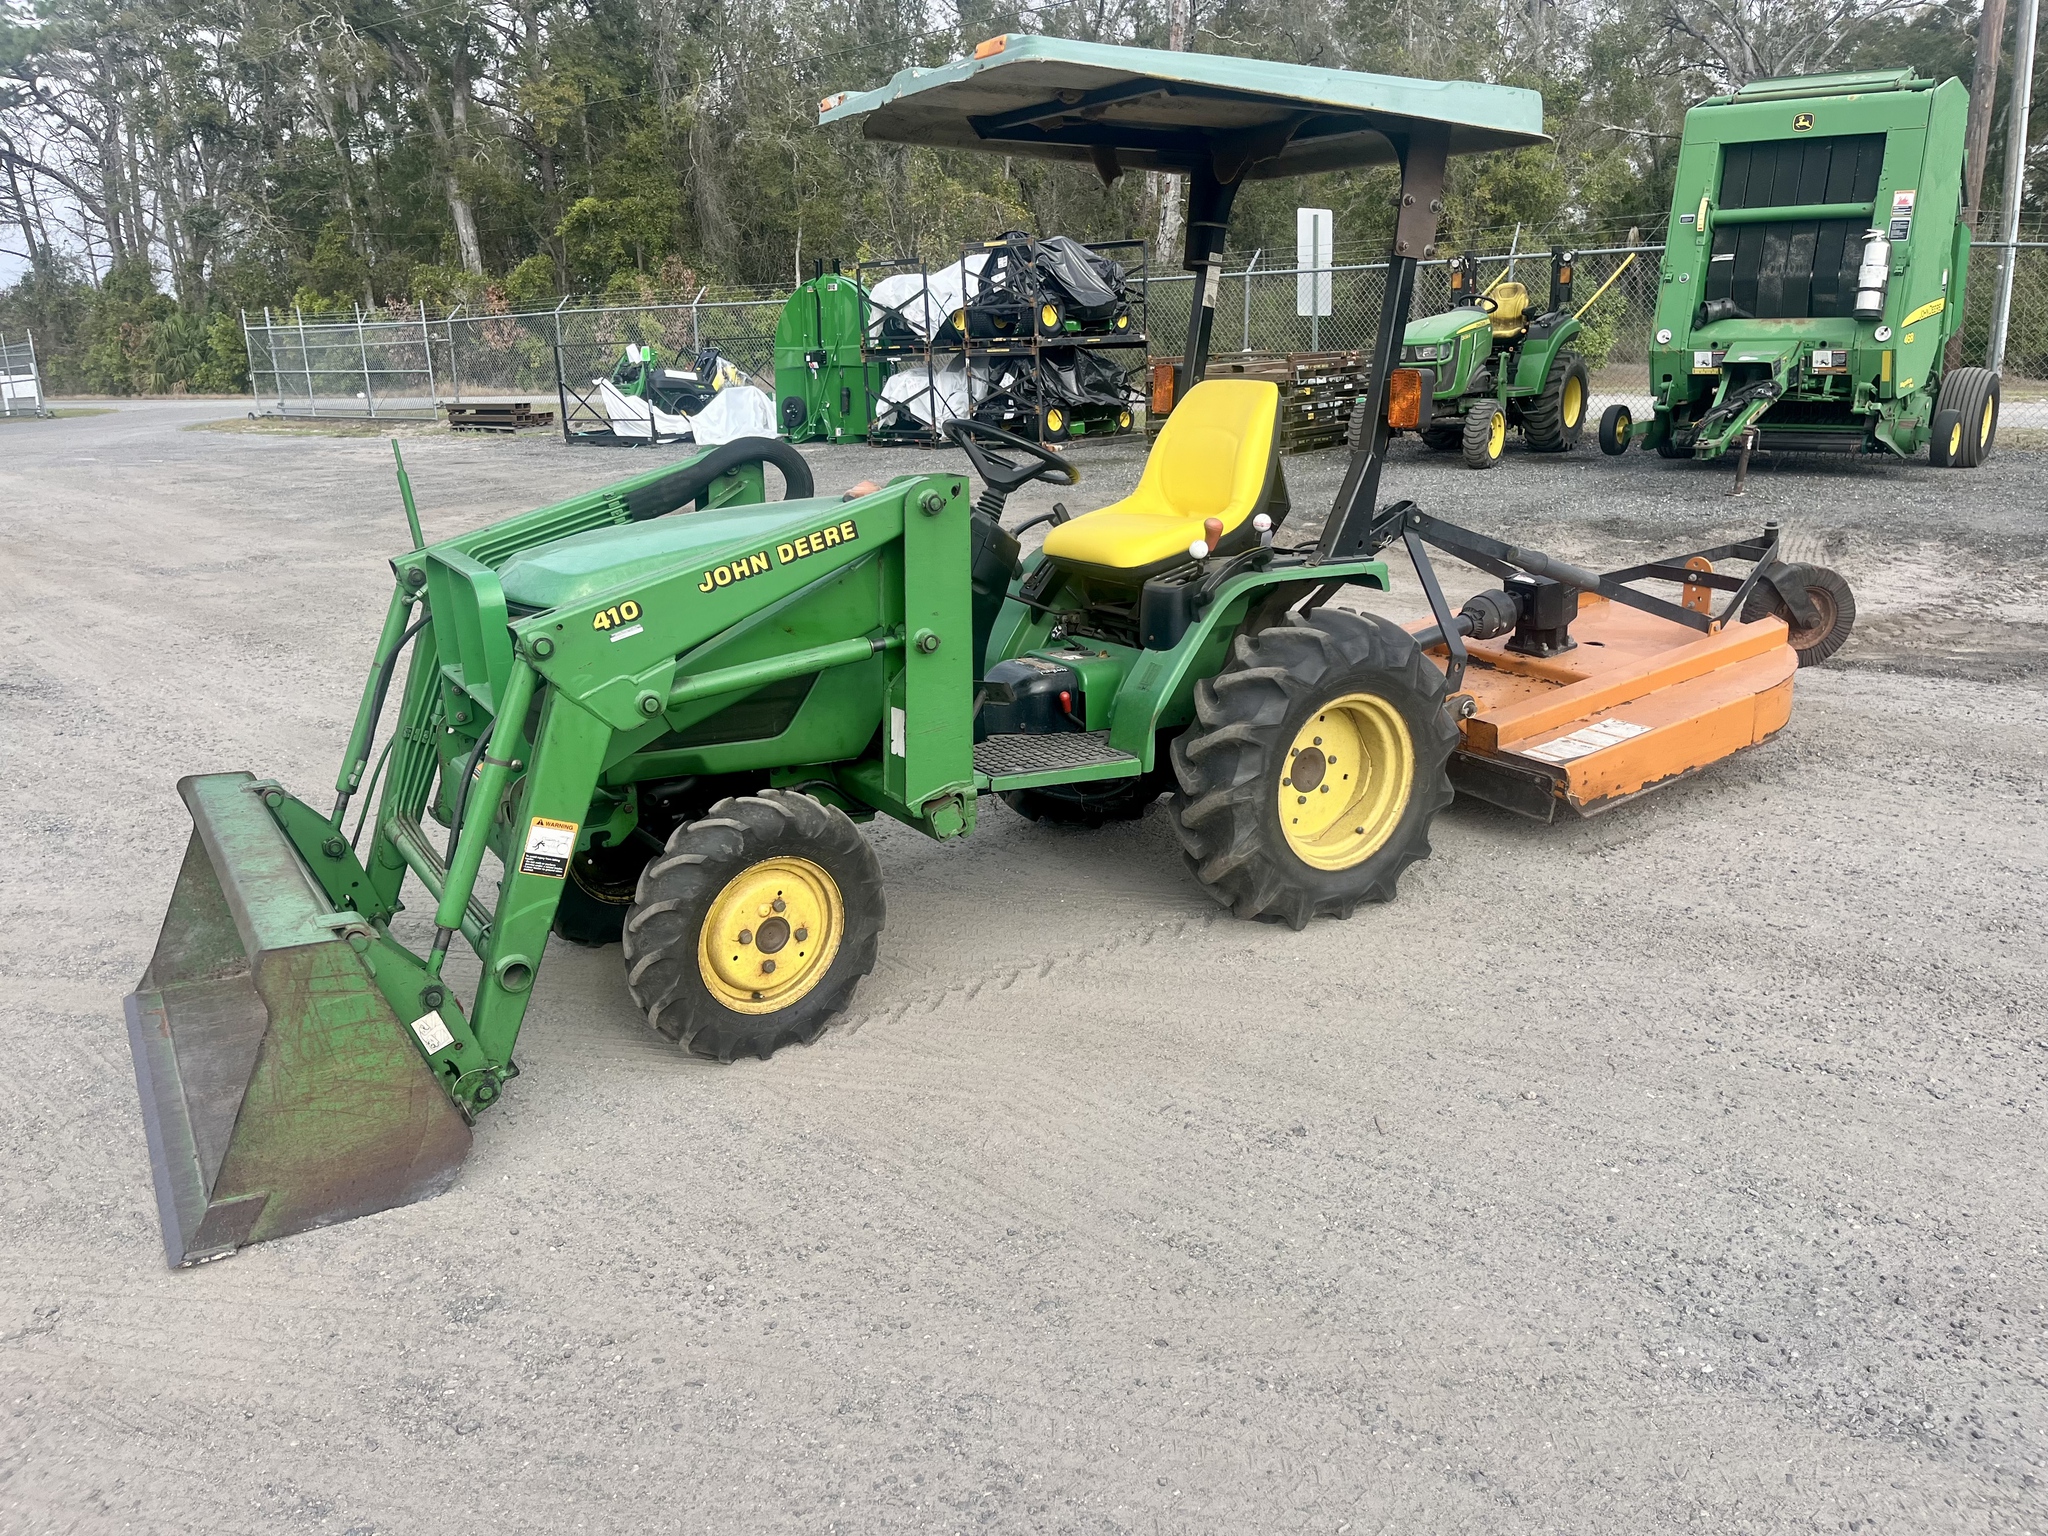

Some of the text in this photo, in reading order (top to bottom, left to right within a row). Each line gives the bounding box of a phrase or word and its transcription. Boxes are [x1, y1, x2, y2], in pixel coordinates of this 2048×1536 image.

[698, 521, 858, 593] JOHN DEERE
[593, 600, 643, 631] 410
[545, 821, 573, 830] WARNING
